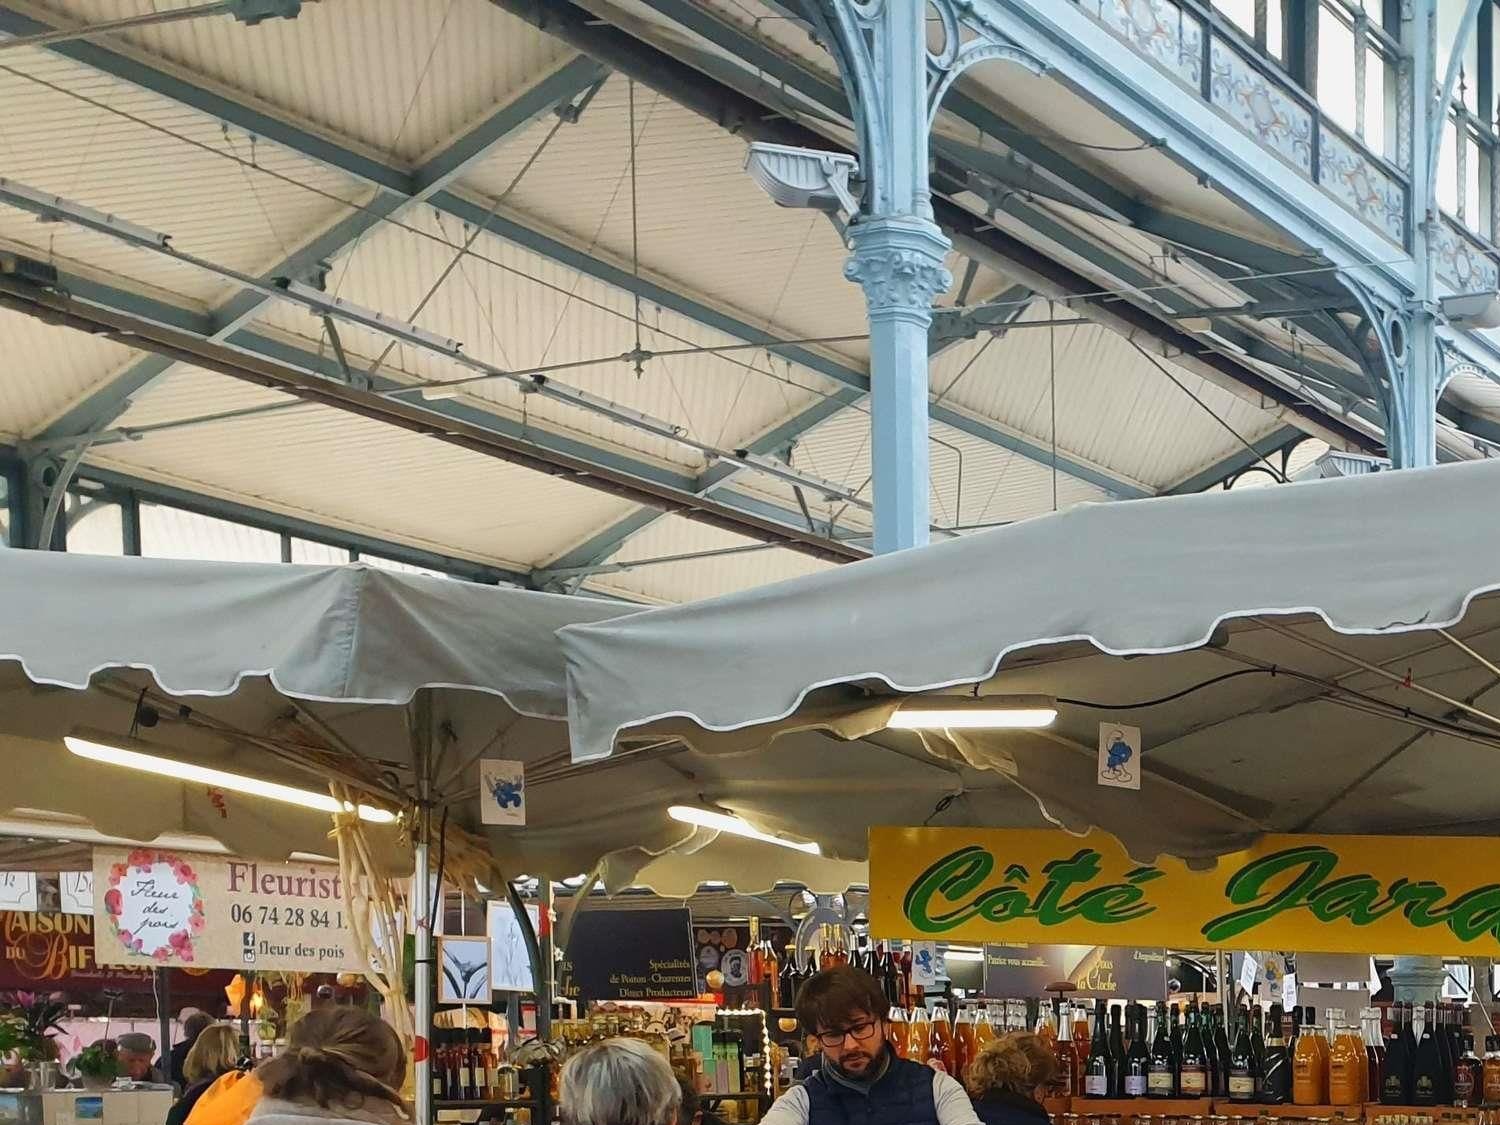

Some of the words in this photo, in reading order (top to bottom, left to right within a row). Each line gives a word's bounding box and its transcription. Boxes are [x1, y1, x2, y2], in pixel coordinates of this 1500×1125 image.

[131, 880, 179, 899] Fleur
[227, 861, 342, 899] Fleurist
[903, 845, 1165, 933] Côté
[142, 902, 168, 914] des
[231, 903, 252, 924] 06
[259, 905, 279, 925] 74
[285, 907, 304, 927] 28
[310, 909, 329, 928] 84
[133, 918, 179, 935] pois
[259, 940, 290, 956] fleur
[294, 943, 317, 957] des
[319, 944, 345, 960] pois
